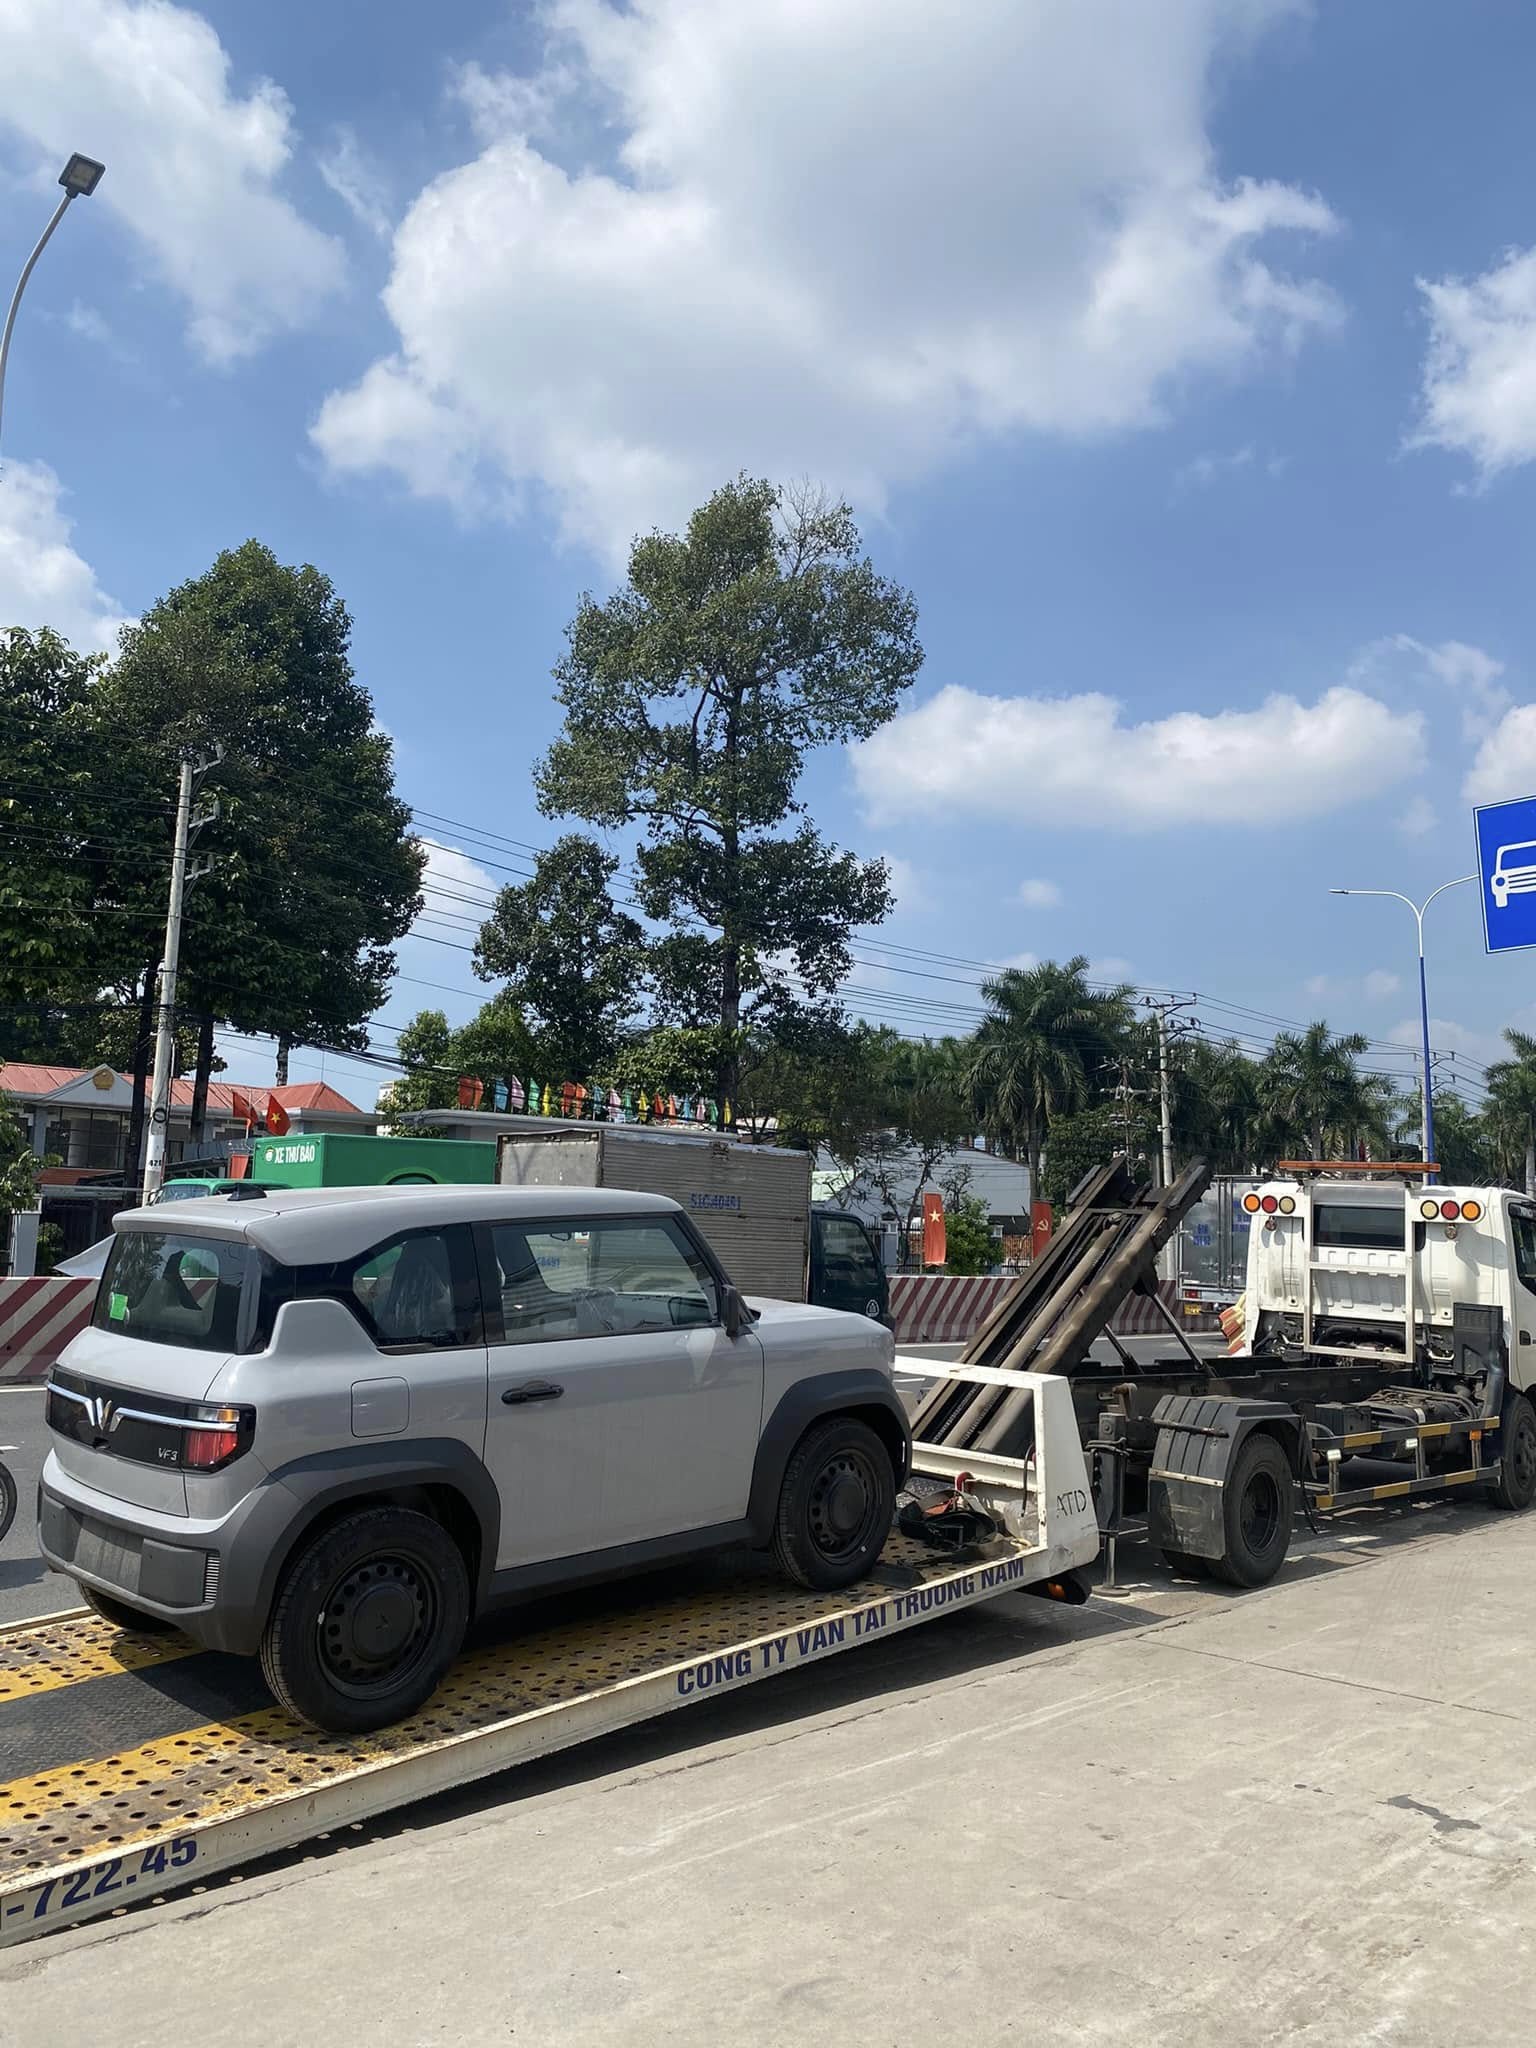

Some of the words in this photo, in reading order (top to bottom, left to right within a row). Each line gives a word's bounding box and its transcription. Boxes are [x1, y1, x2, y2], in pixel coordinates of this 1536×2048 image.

[274, 1147, 284, 1164] XE
[1056, 1489, 1087, 1518] ATD
[677, 1649, 751, 1695] CONG
[760, 1638, 788, 1668] TY
[797, 1617, 845, 1656] VAN
[852, 1602, 888, 1636] TAI
[894, 1575, 975, 1621] TRUONG
[981, 1558, 1024, 1589] NAM
